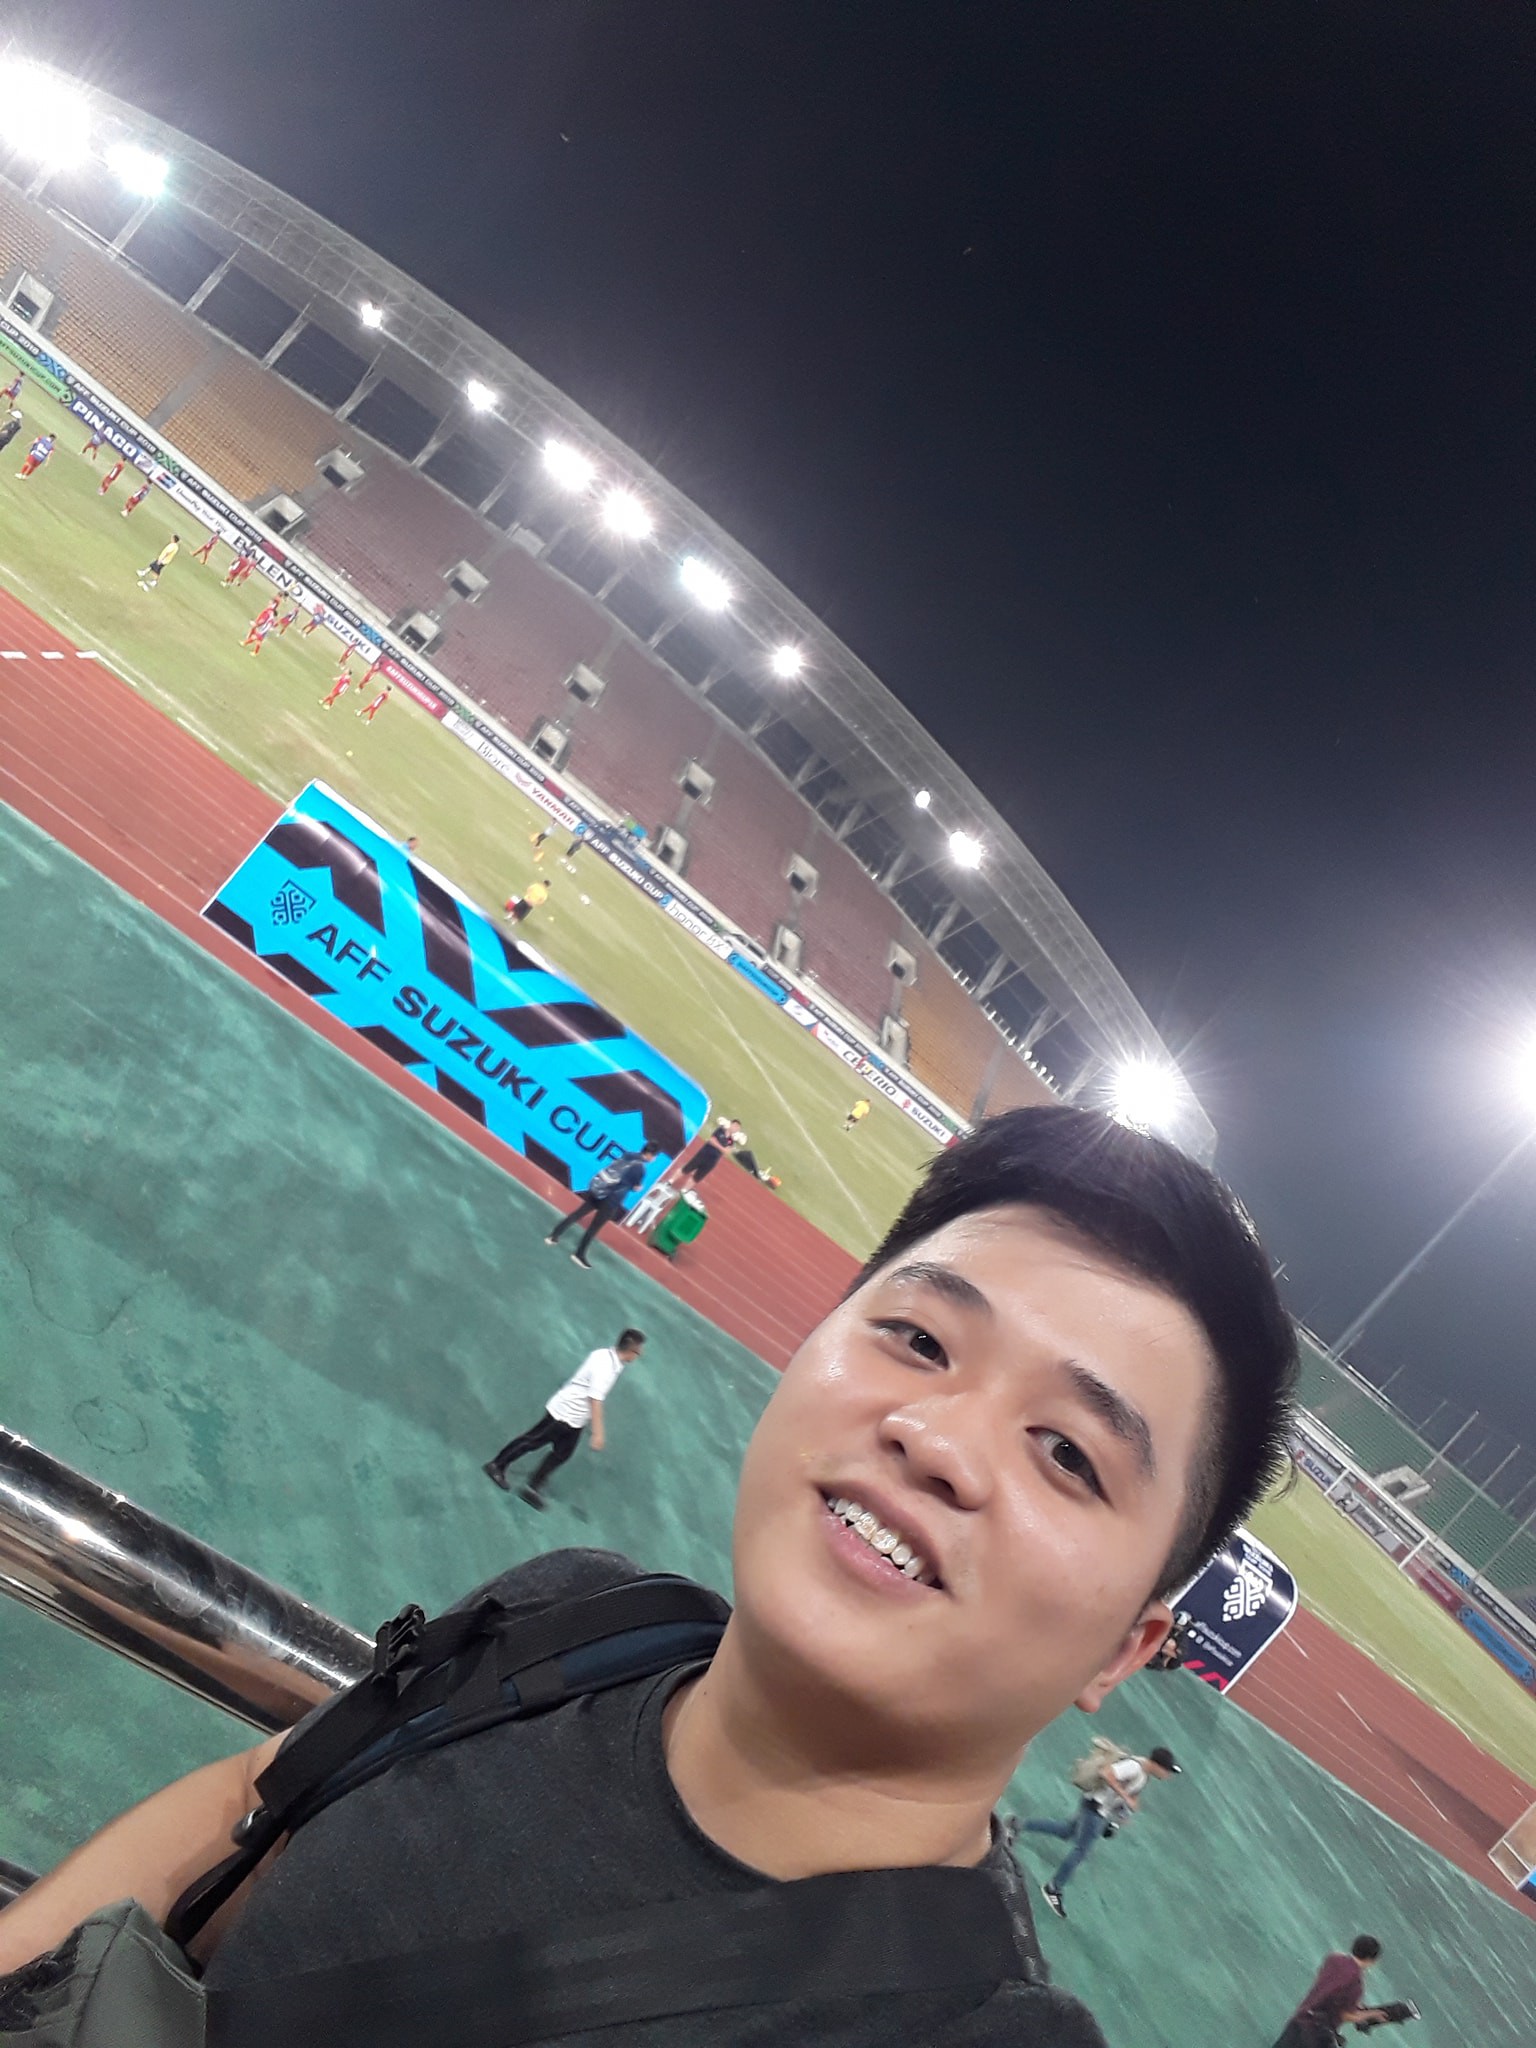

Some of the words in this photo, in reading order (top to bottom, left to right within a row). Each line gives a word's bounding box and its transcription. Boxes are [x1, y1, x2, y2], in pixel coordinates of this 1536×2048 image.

[90, 395, 122, 424] SUZUKI
[325, 612, 372, 655] SUZUKI
[609, 852, 645, 886] SUZUKI
[643, 877, 664, 901] CUP
[306, 923, 392, 984] AFF
[391, 985, 548, 1111] SUZUKI
[548, 1105, 627, 1164] CUP
[910, 1107, 946, 1138] SUZUKI
